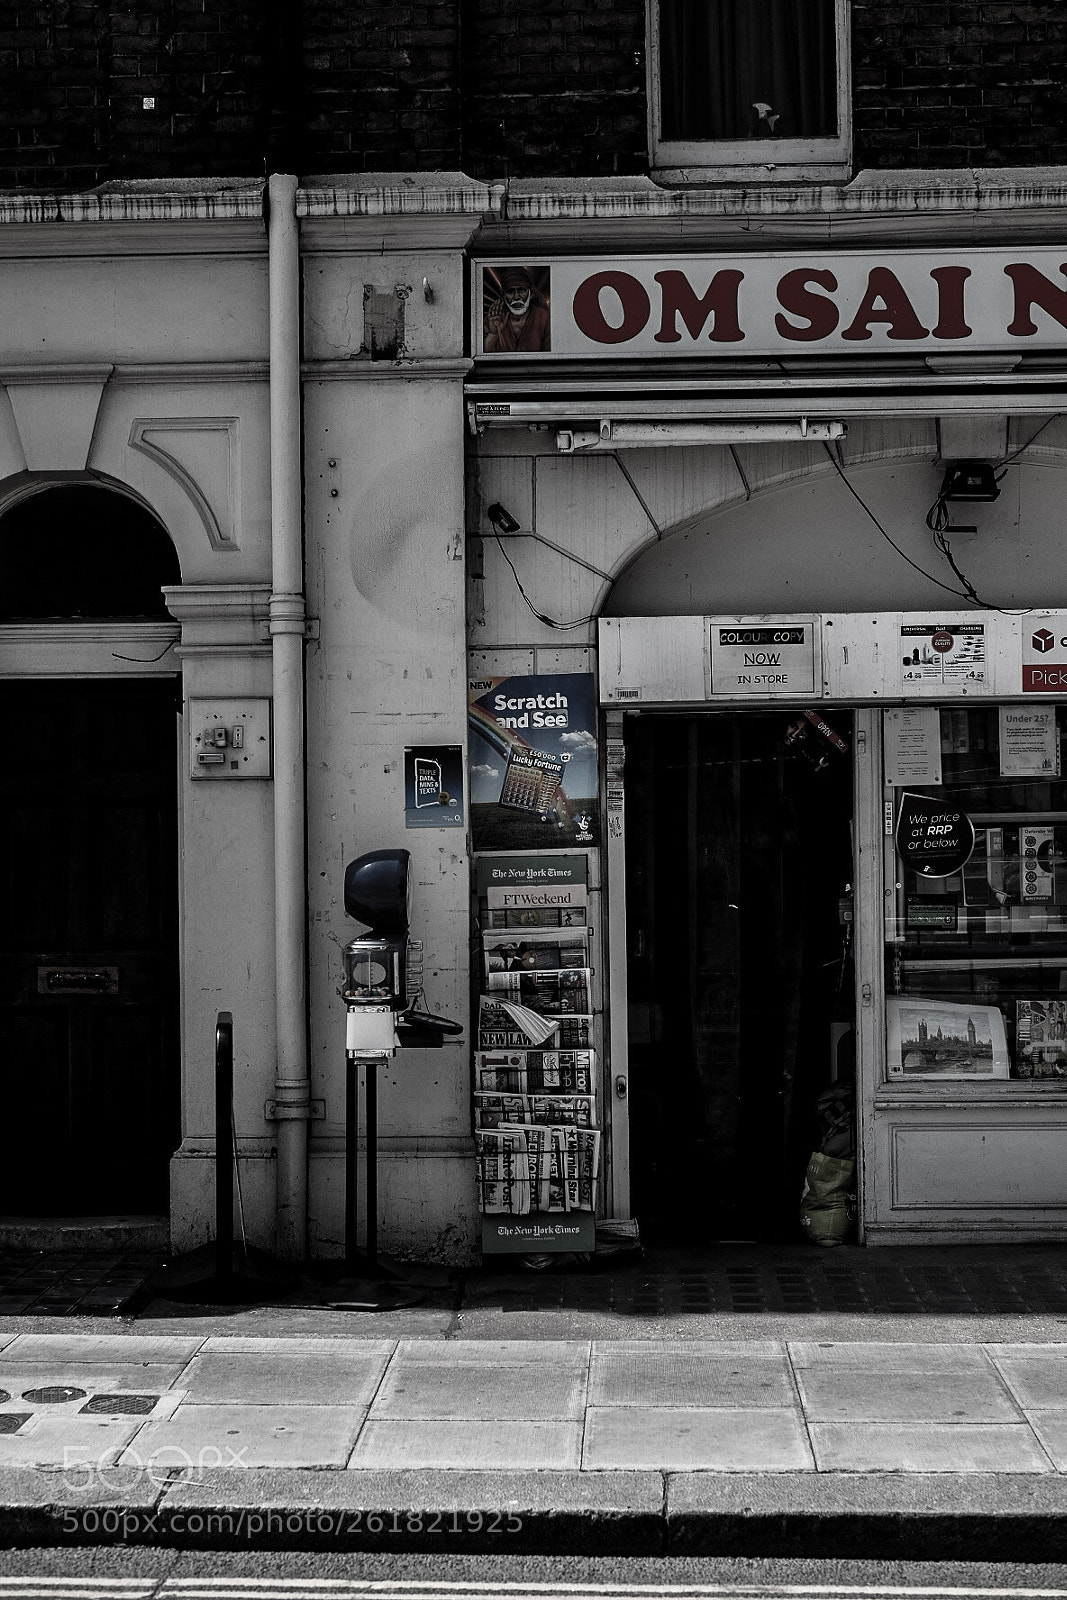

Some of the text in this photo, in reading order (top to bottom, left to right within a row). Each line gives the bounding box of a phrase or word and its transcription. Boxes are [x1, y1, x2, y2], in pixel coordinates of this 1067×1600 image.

[572, 269, 745, 344] OM
[774, 266, 973, 342] SAI
[720, 631, 804, 643] COLOUR COPY
[744, 653, 781, 665] NOW
[737, 674, 788, 684] IN STORE
[1031, 669, 1067, 685] Pick
[469, 681, 493, 690] NEW
[494, 692, 568, 711] Scratch
[495, 711, 567, 729] and See
[1006, 714, 1049, 723] Under 25?
[817, 722, 833, 737] OPEN
[512, 754, 562, 772] Lucky Fortune
[418, 768, 437, 776] TRIPLE
[909, 813, 960, 825] We price
[911, 825, 953, 837] at RRP
[907, 838, 959, 850] or below
[491, 868, 572, 879] The New York Times
[480, 1032, 506, 1046] NEW
[576, 1051, 590, 1093] Mirror
[502, 1136, 515, 1207] Irish Post
[581, 1133, 596, 1204] RACING POST
[568, 1181, 577, 1203] Star
[497, 1224, 580, 1237] The New York Times
